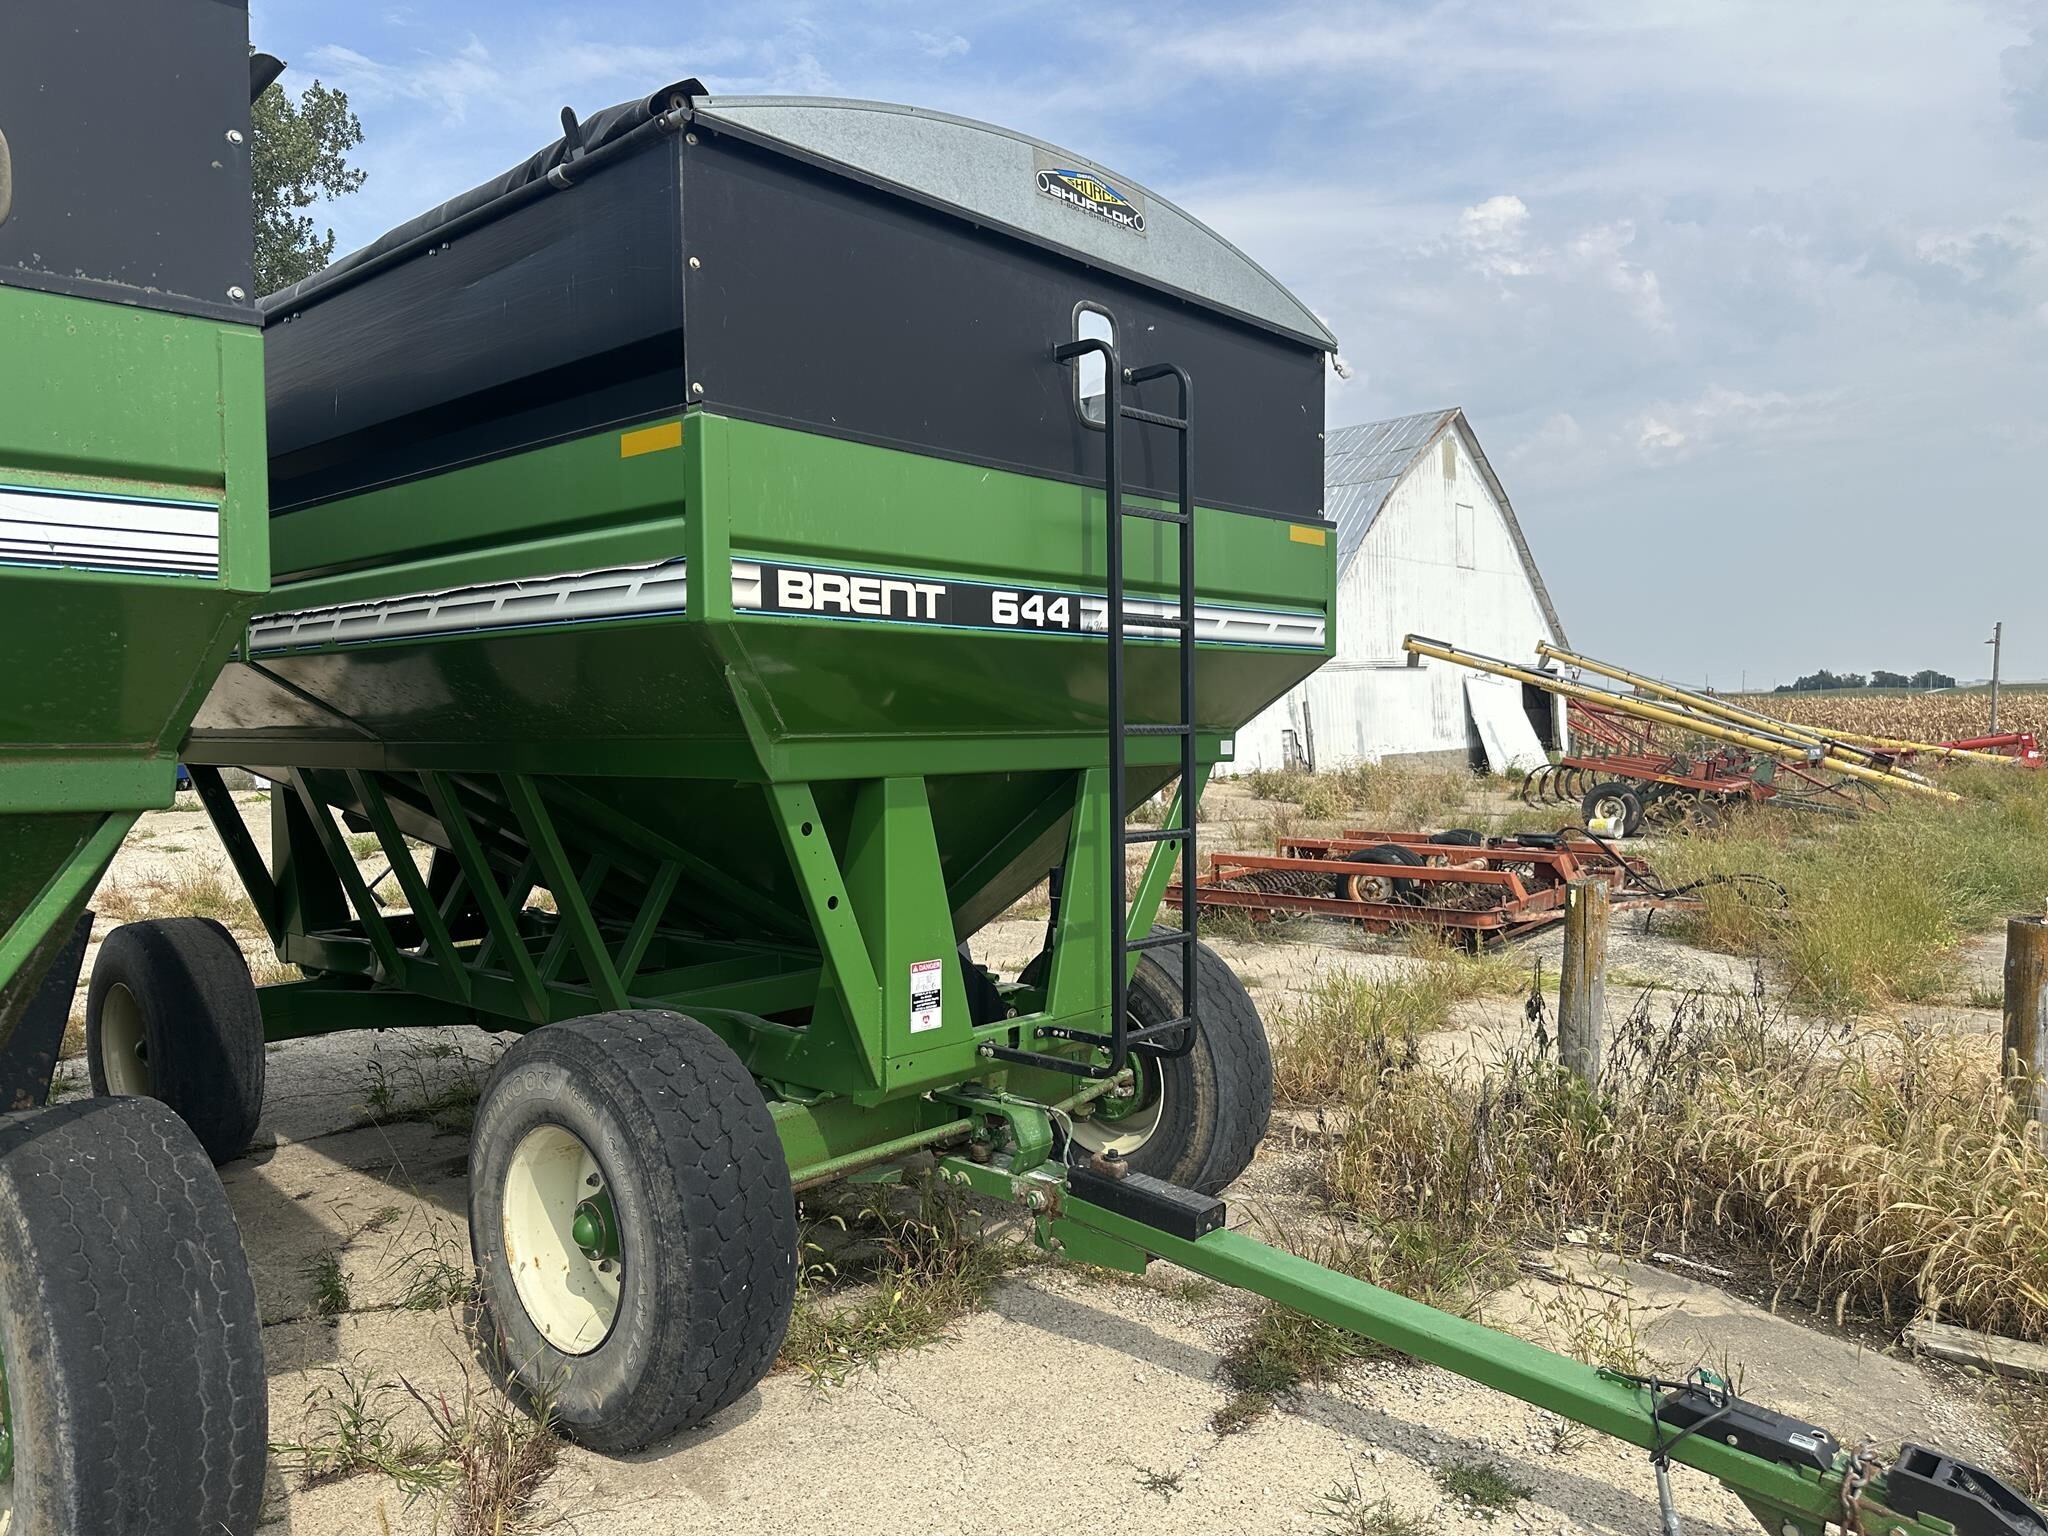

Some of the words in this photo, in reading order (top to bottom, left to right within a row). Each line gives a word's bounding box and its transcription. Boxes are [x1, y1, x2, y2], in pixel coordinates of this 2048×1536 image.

[1049, 184, 1134, 228] SHUR-LOK
[777, 569, 946, 619] BRENT
[992, 590, 1070, 629] 644
